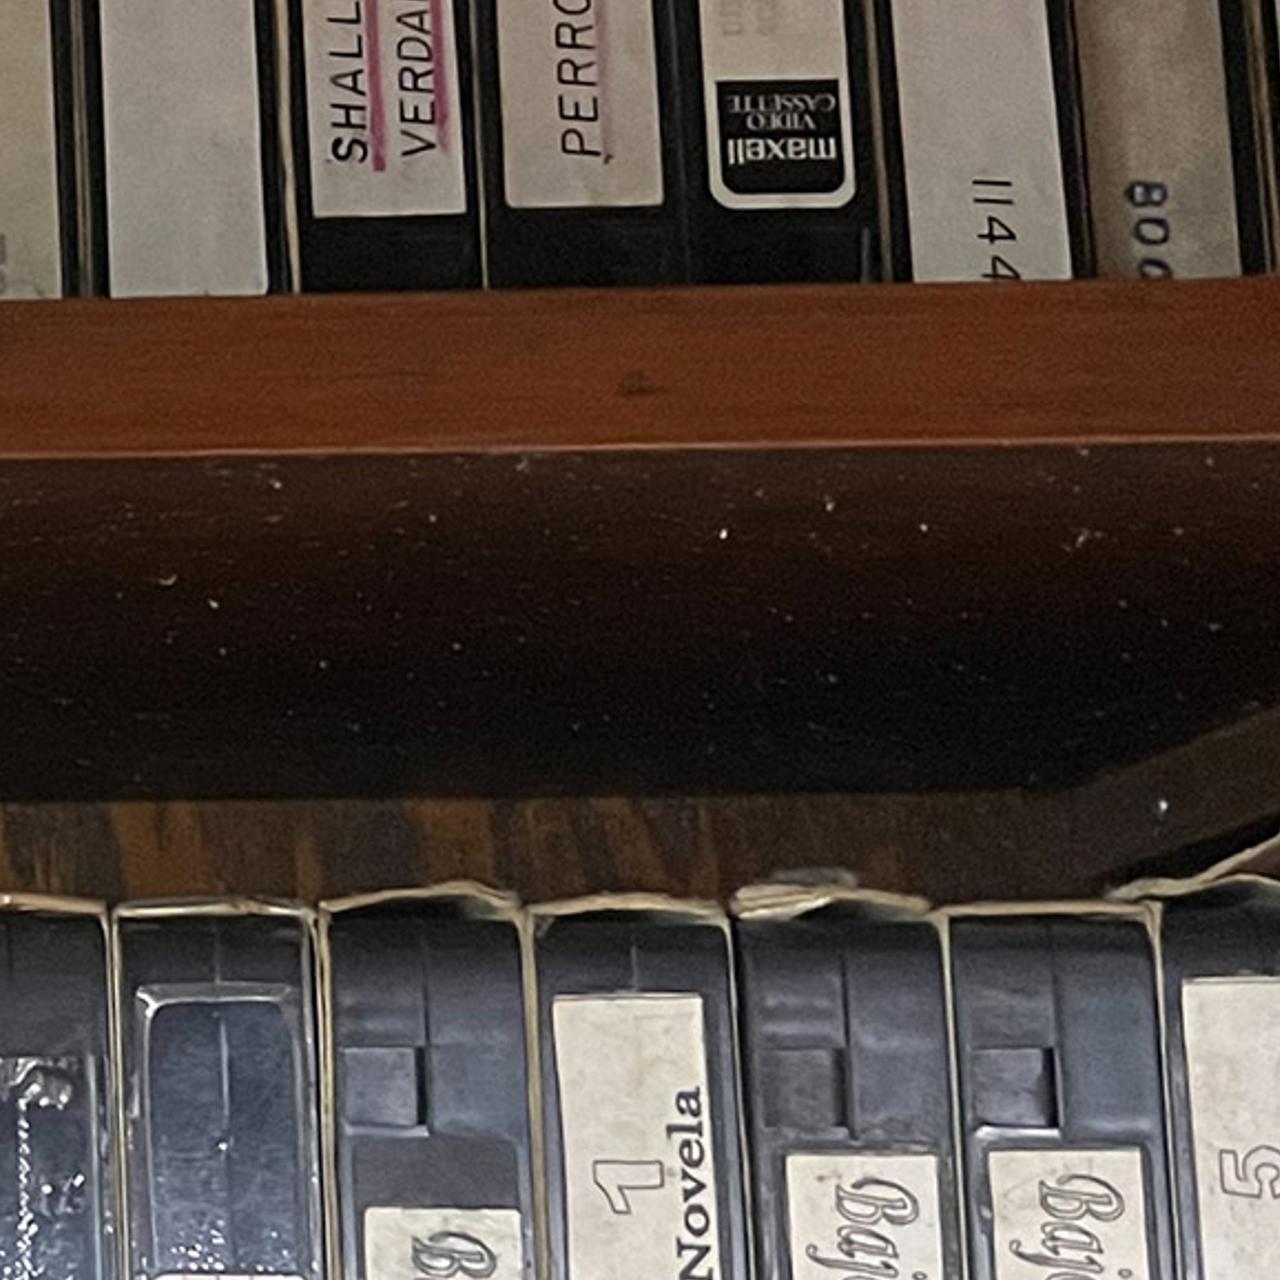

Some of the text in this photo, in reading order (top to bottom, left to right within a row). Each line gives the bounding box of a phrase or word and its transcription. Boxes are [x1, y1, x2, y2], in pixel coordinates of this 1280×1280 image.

[726, 92, 837, 115] CASSETTE
[744, 113, 818, 133] VIDEO
[727, 136, 837, 166] maxell
